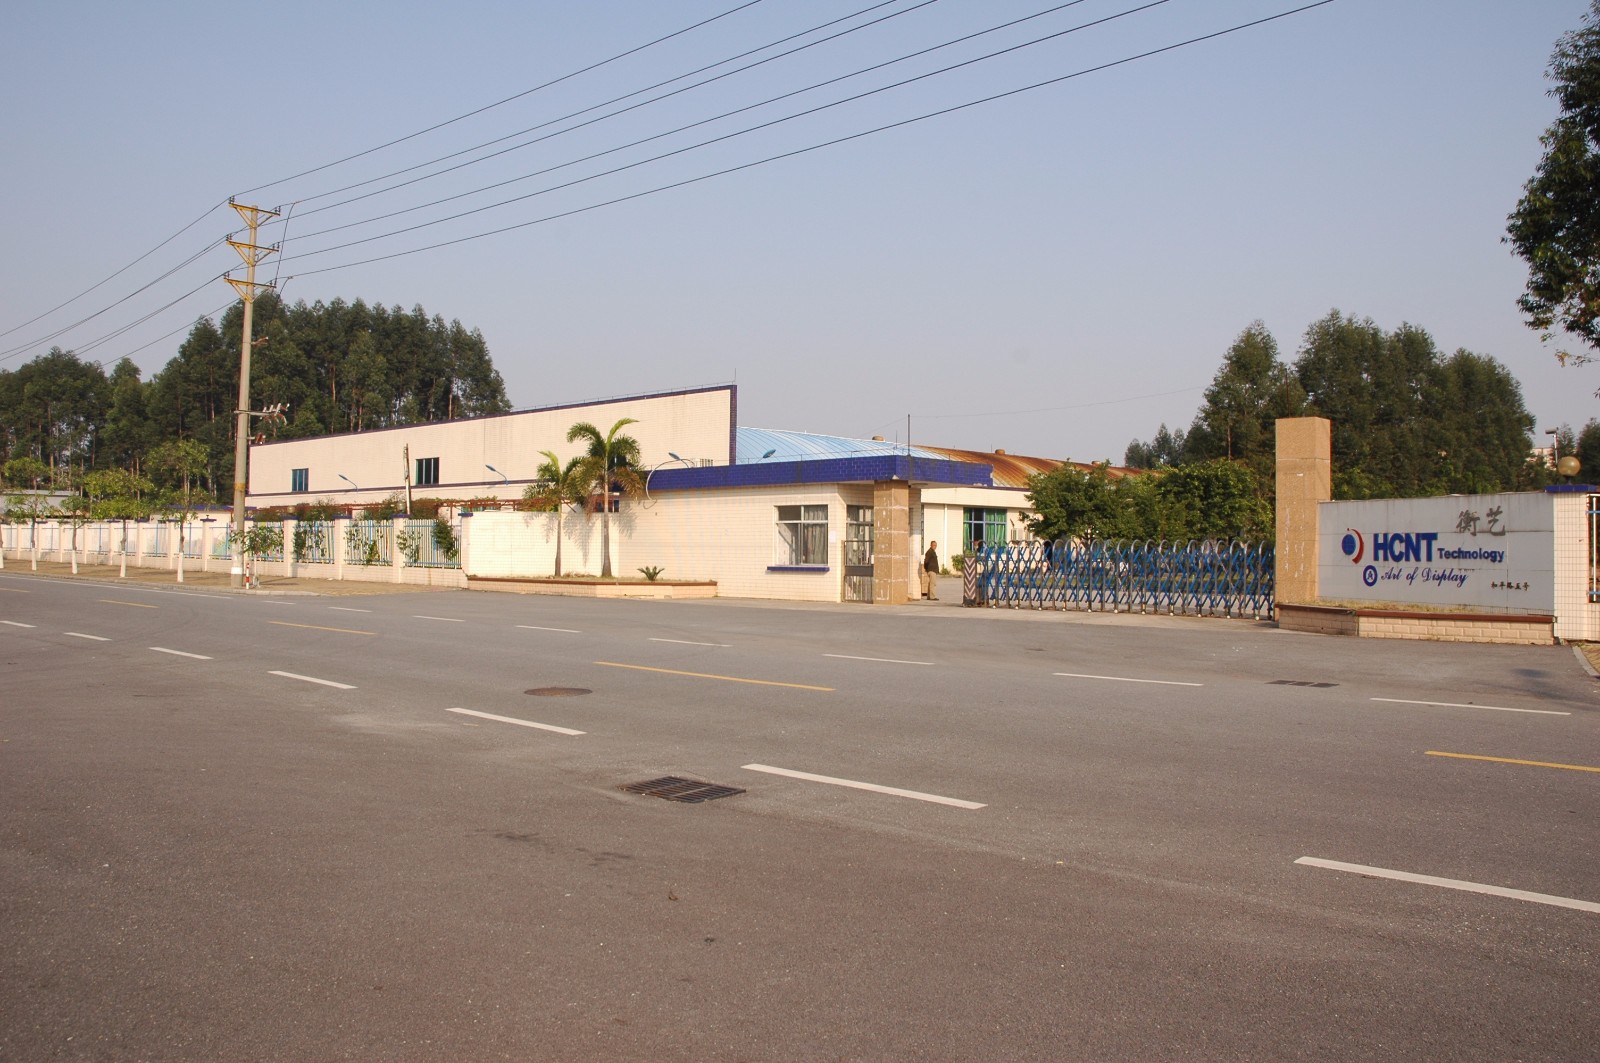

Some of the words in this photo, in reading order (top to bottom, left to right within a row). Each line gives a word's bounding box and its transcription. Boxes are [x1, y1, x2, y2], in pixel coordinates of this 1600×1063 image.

[1456, 505, 1506, 537] 衡艺
[1373, 532, 1438, 562] HCNT
[1437, 547, 1504, 563] Technology
[1381, 567, 1402, 580] Art
[1406, 567, 1419, 586] of
[1421, 568, 1468, 588] Display
